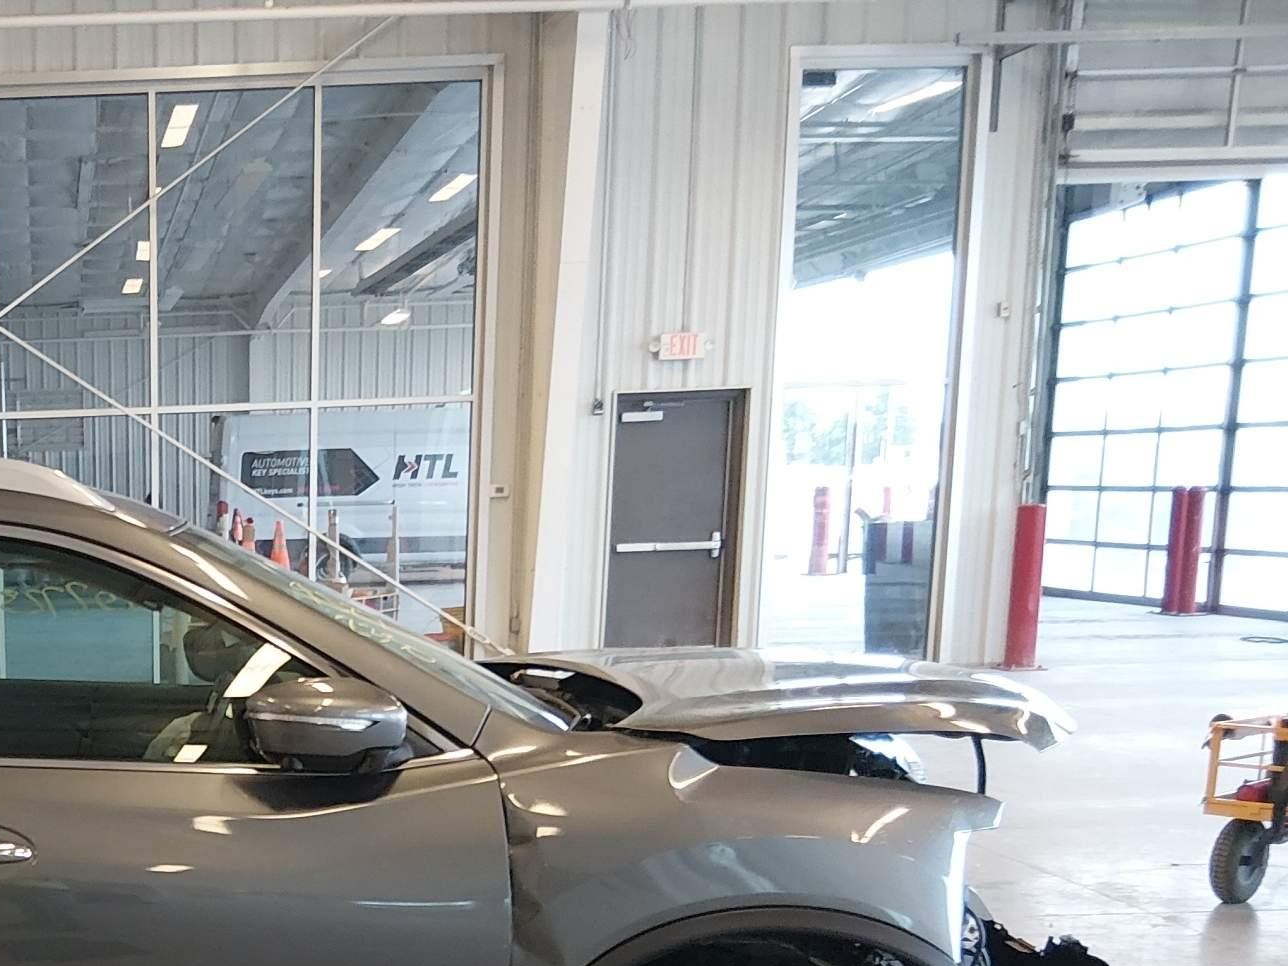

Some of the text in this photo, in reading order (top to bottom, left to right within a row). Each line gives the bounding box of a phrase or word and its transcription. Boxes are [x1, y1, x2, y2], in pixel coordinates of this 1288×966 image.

[669, 334, 697, 356] EXIT
[251, 468, 267, 477] KEY
[392, 453, 459, 481] HTL
